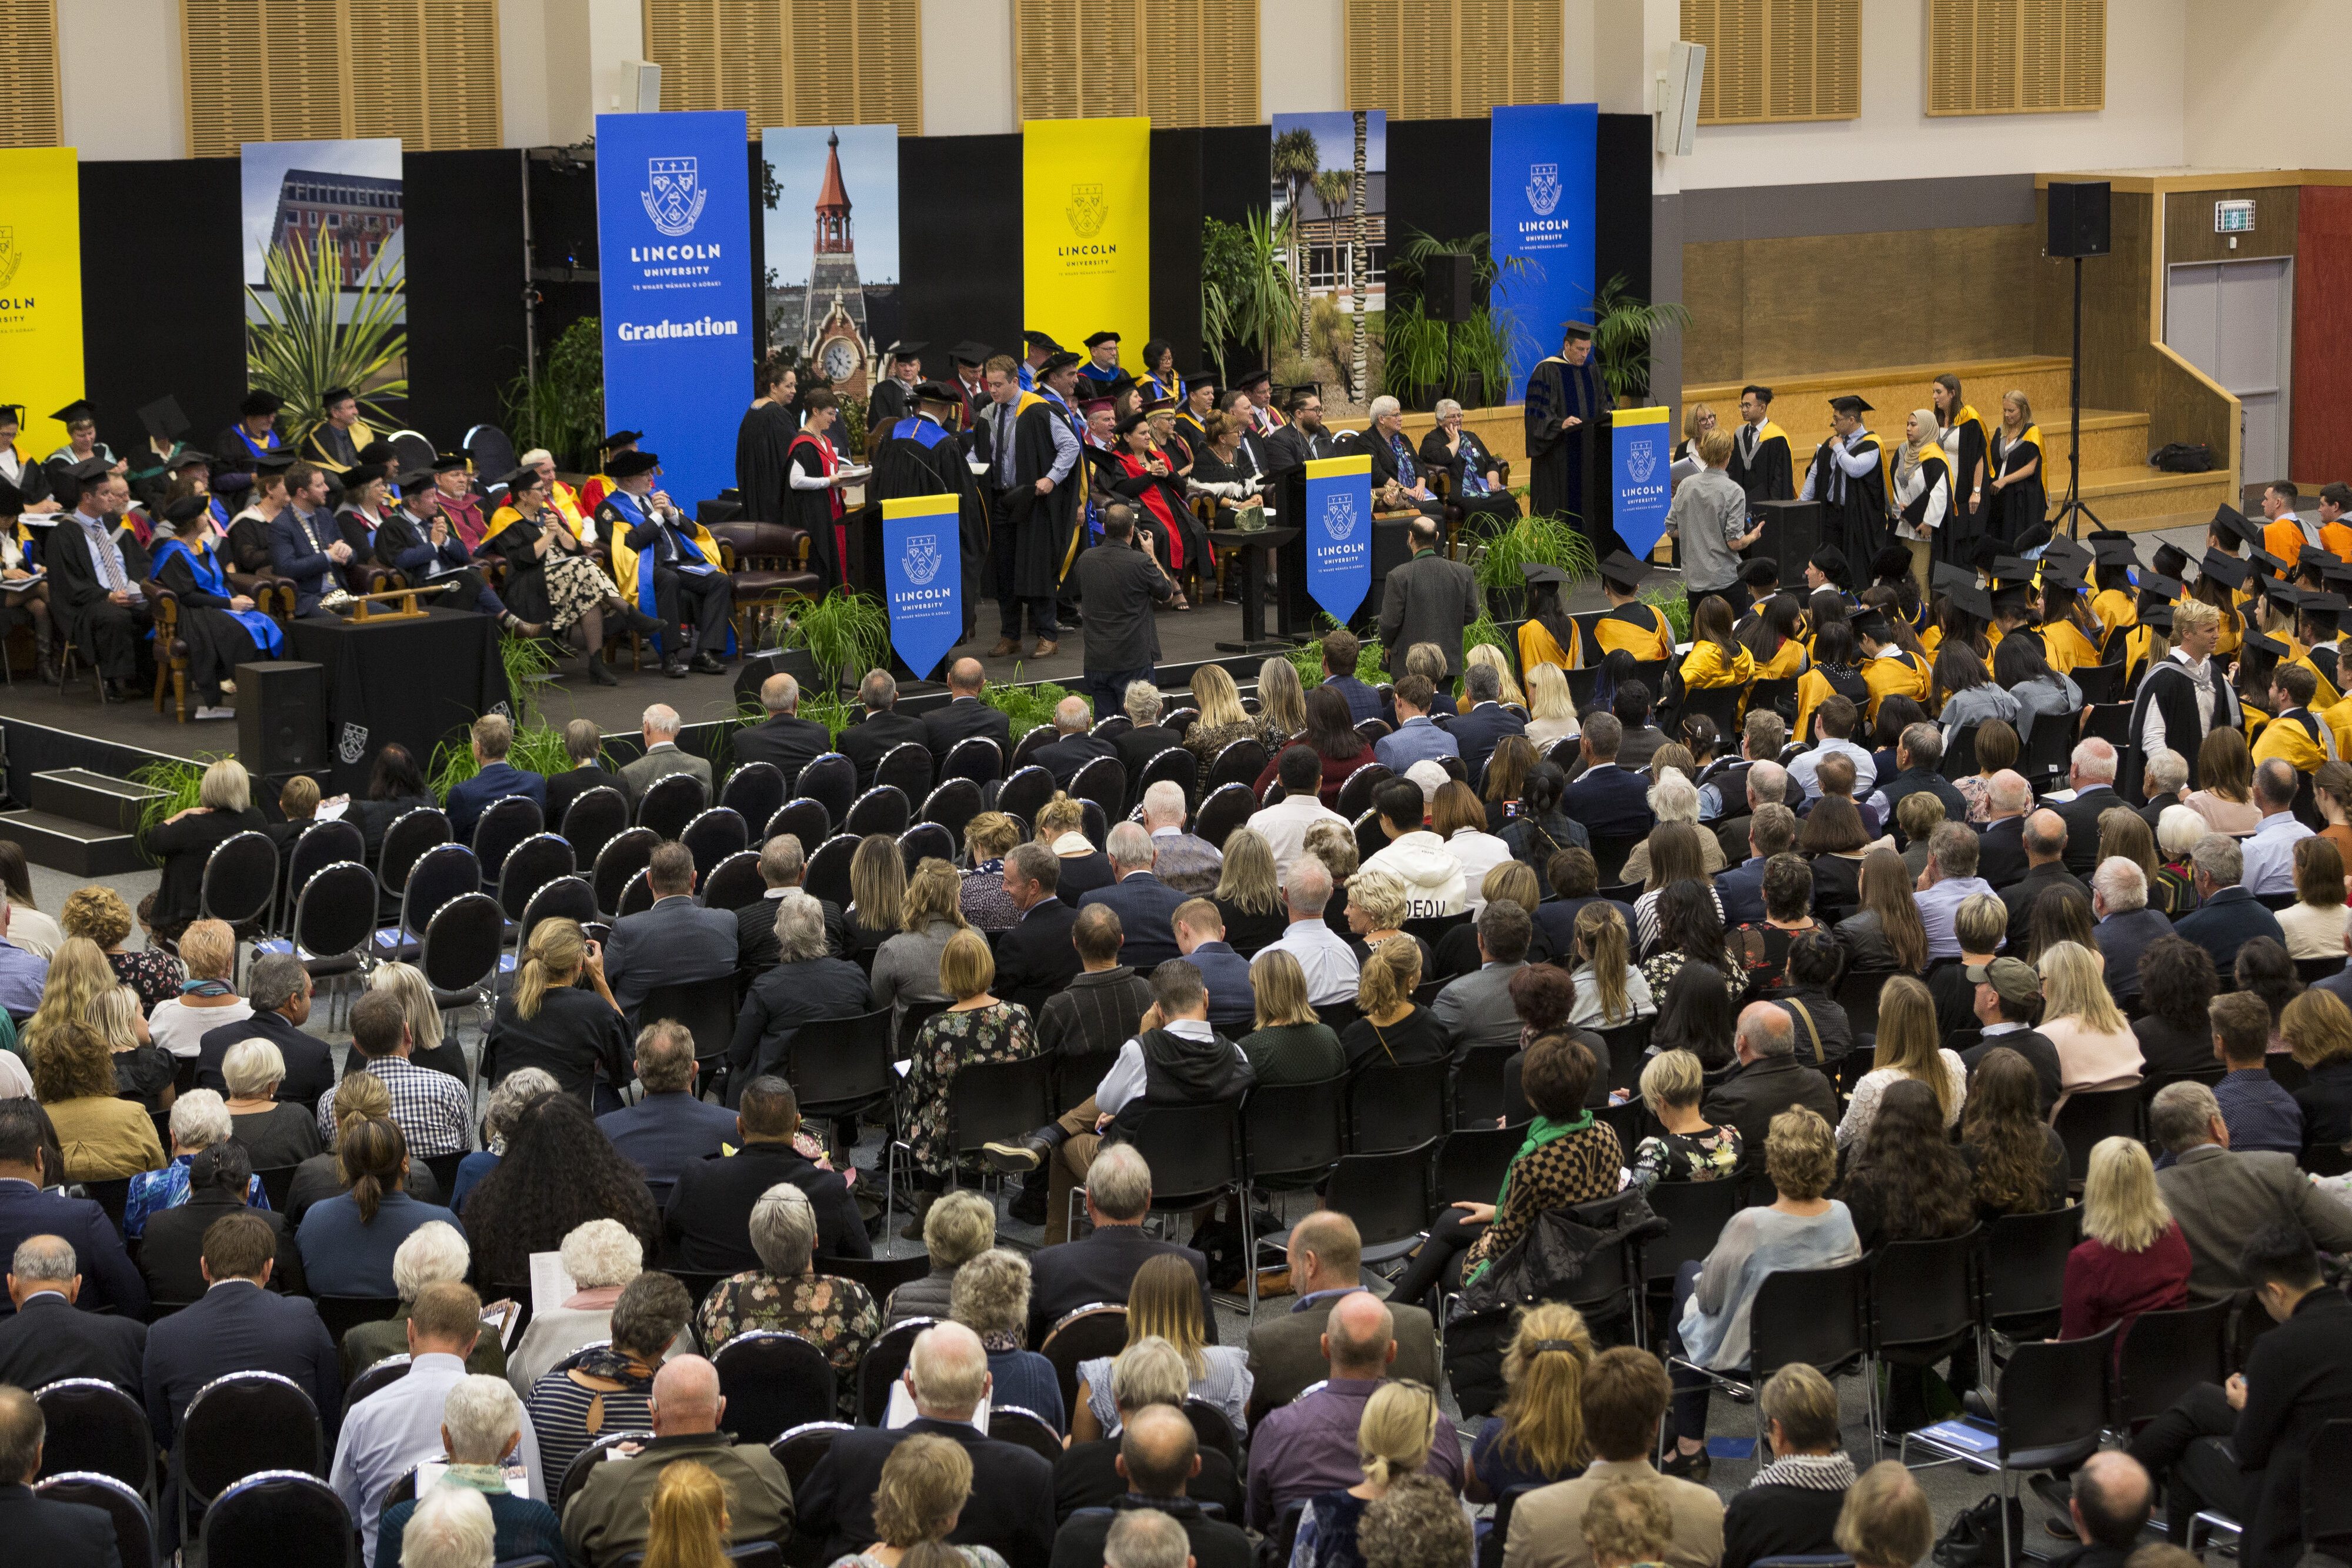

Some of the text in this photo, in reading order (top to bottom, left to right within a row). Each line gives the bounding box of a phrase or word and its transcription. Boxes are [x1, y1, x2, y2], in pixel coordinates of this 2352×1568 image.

[1519, 219, 1569, 232] LINCOLN
[631, 243, 720, 262] LINCOLN
[1059, 244, 1116, 256] LINCOLN
[644, 266, 710, 277] UNIVERSITY
[618, 316, 738, 341] Graduation
[1622, 485, 1663, 497] LINCOLN
[1317, 543, 1364, 556] LINCOLN
[1324, 556, 1358, 565] UNIVERSITY
[895, 588, 950, 602] LINCOLN
[902, 602, 943, 611] UNIVERSITY
